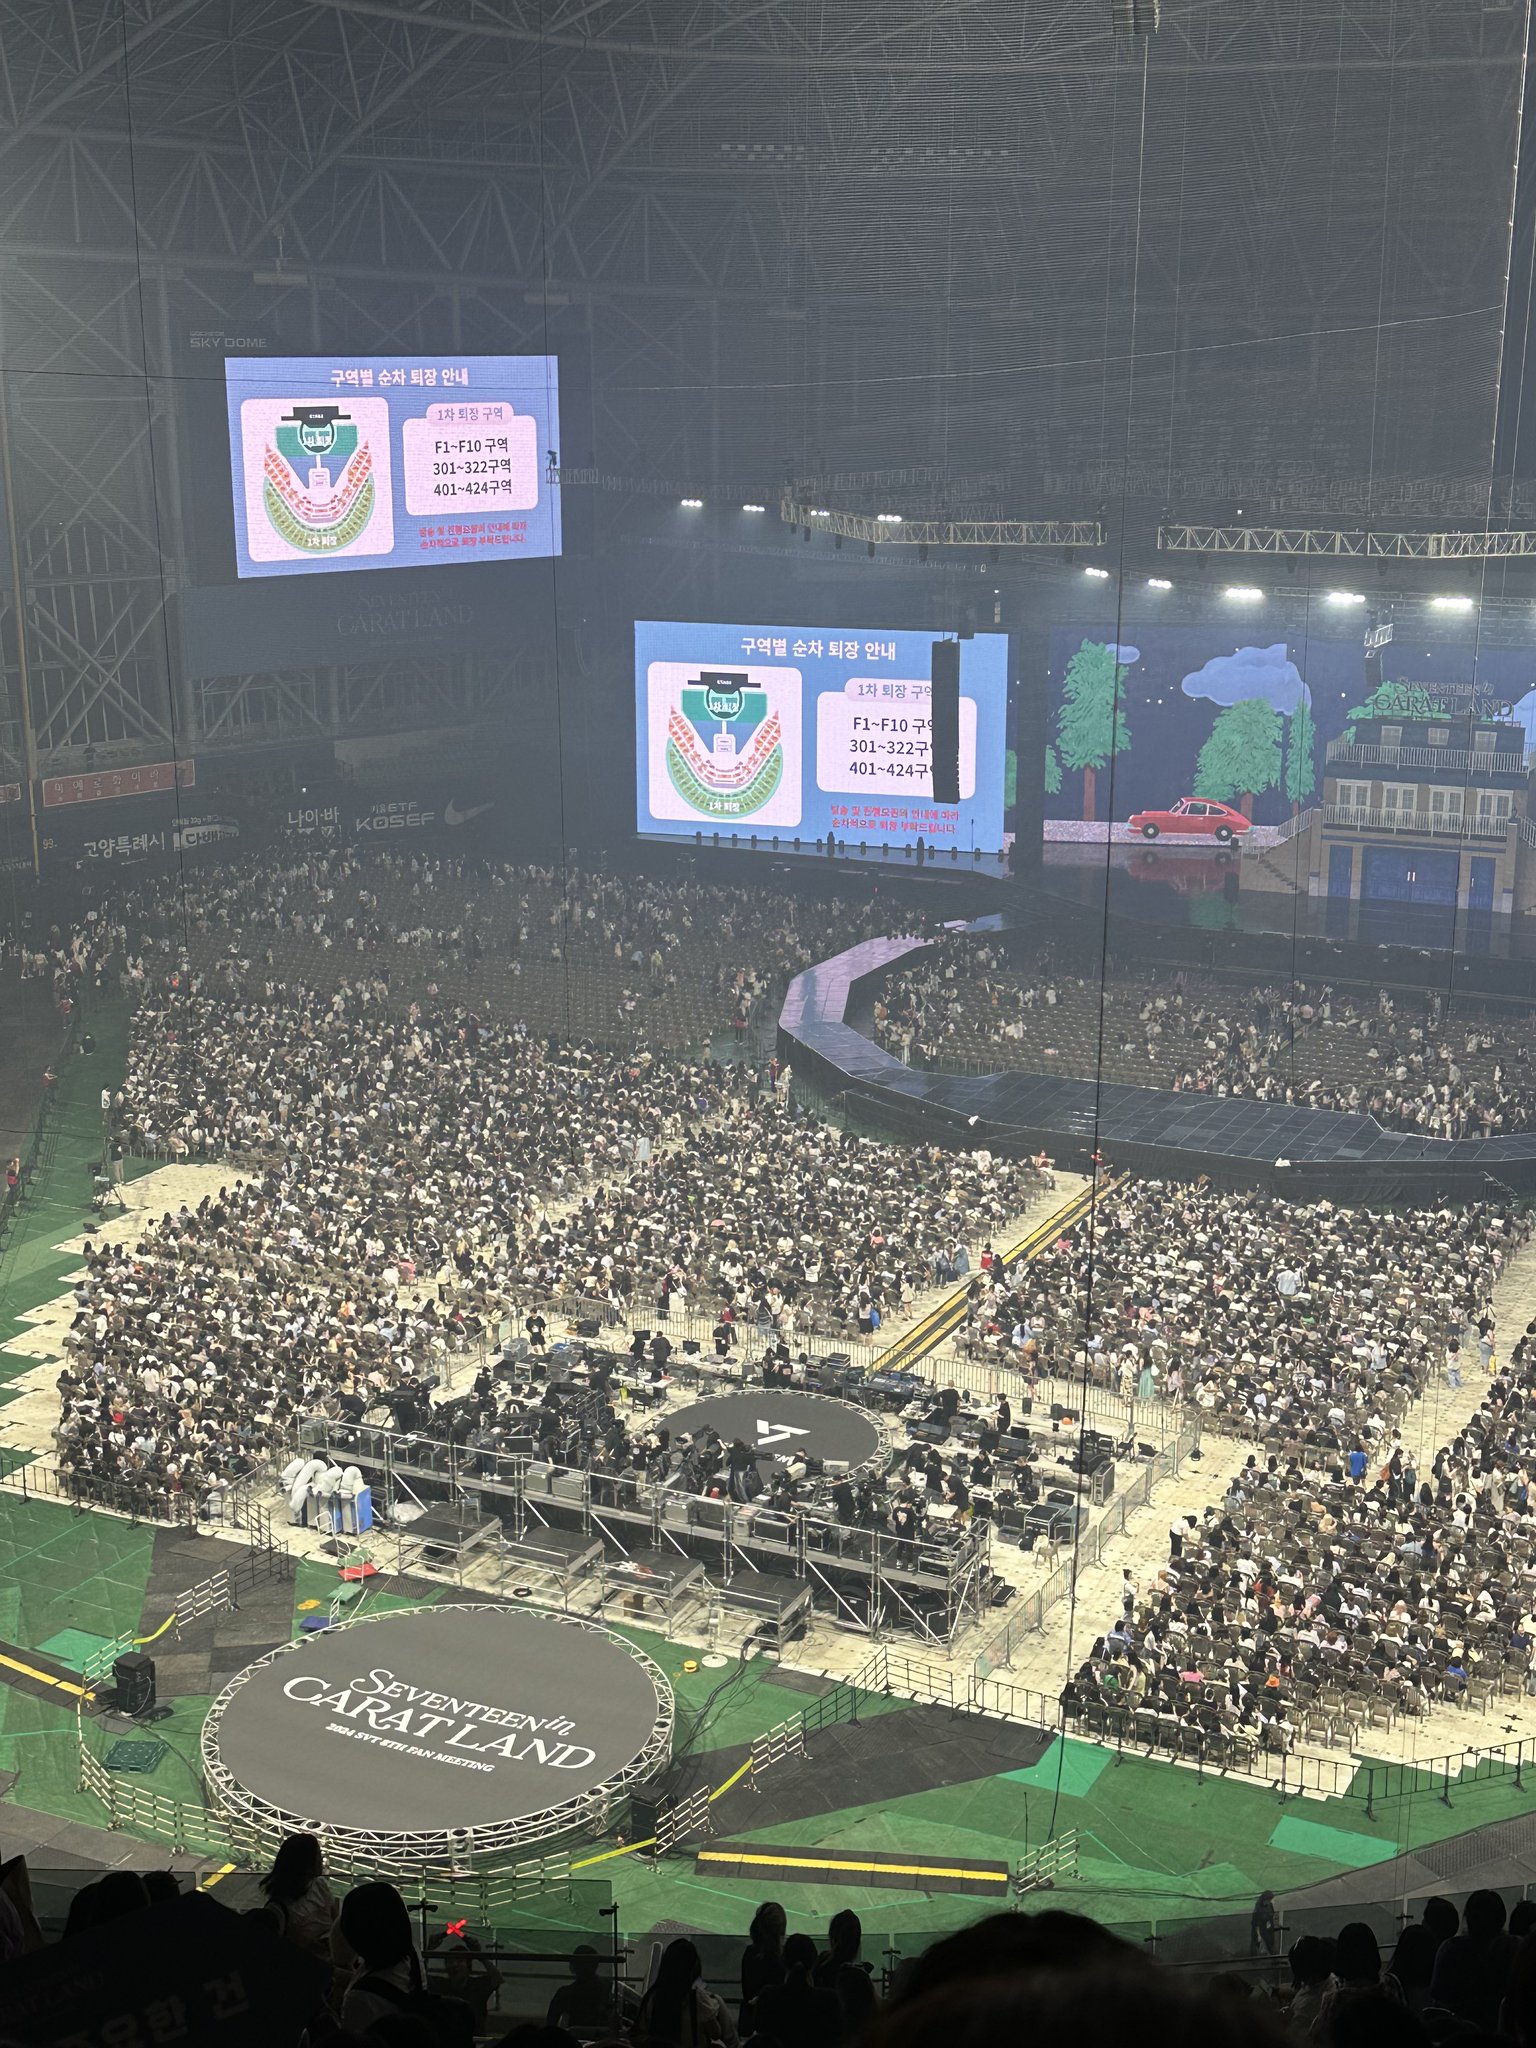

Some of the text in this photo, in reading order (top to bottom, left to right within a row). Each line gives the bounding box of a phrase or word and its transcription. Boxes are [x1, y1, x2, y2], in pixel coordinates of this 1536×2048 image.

[190, 337, 267, 348] SKY DOME
[330, 367, 469, 388] 구역별 순차 퇴장 안내
[437, 406, 504, 421] 1차 퇴장 구역
[434, 437, 509, 454] F1~F10 구역
[432, 458, 512, 476] 301~322구역
[433, 479, 513, 496] 401~424구역
[741, 637, 897, 661] 구역별 순차 퇴장 안내
[857, 684, 877, 698] 1차
[882, 683, 907, 700] 퇴장
[1374, 693, 1514, 718] CARAT LAND
[853, 717, 908, 734] F1~F10
[849, 739, 933, 757] 301~322구
[849, 761, 933, 779] 401~424구
[355, 811, 436, 832] KOSEF
[83, 831, 166, 859] 고양특례시
[350, 1668, 577, 1736] SEVENTEEN in
[283, 1676, 597, 1770] CARAT LAND
[354, 1731, 383, 1744] SVT
[406, 1746, 435, 1759] FAN
[432, 1752, 496, 1772] MEETING
